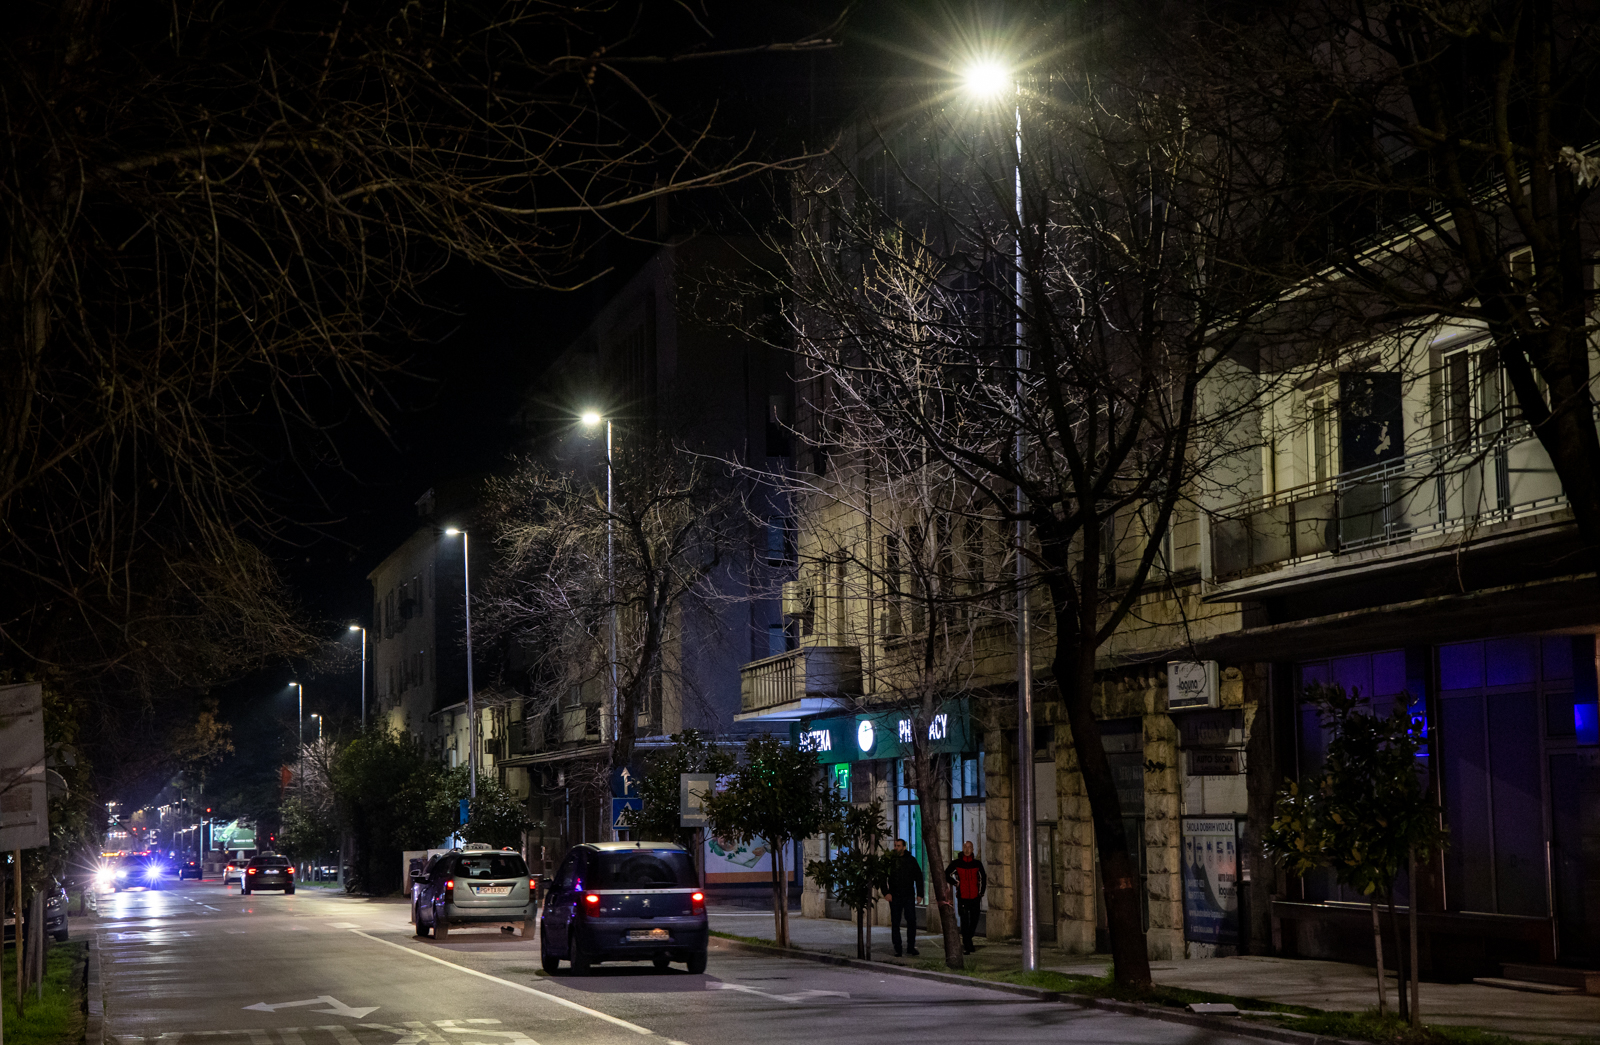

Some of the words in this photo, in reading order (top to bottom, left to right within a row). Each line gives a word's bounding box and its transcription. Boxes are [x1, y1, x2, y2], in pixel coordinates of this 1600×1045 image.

[898, 713, 948, 743] PHACY
[1197, 755, 1212, 763] AUTO
[1214, 754, 1234, 763] ŠKOLA
[1186, 821, 1199, 832] ŠKOLA
[1200, 822, 1216, 832] DOBRIH
[1216, 821, 1233, 832] VOZAČA
